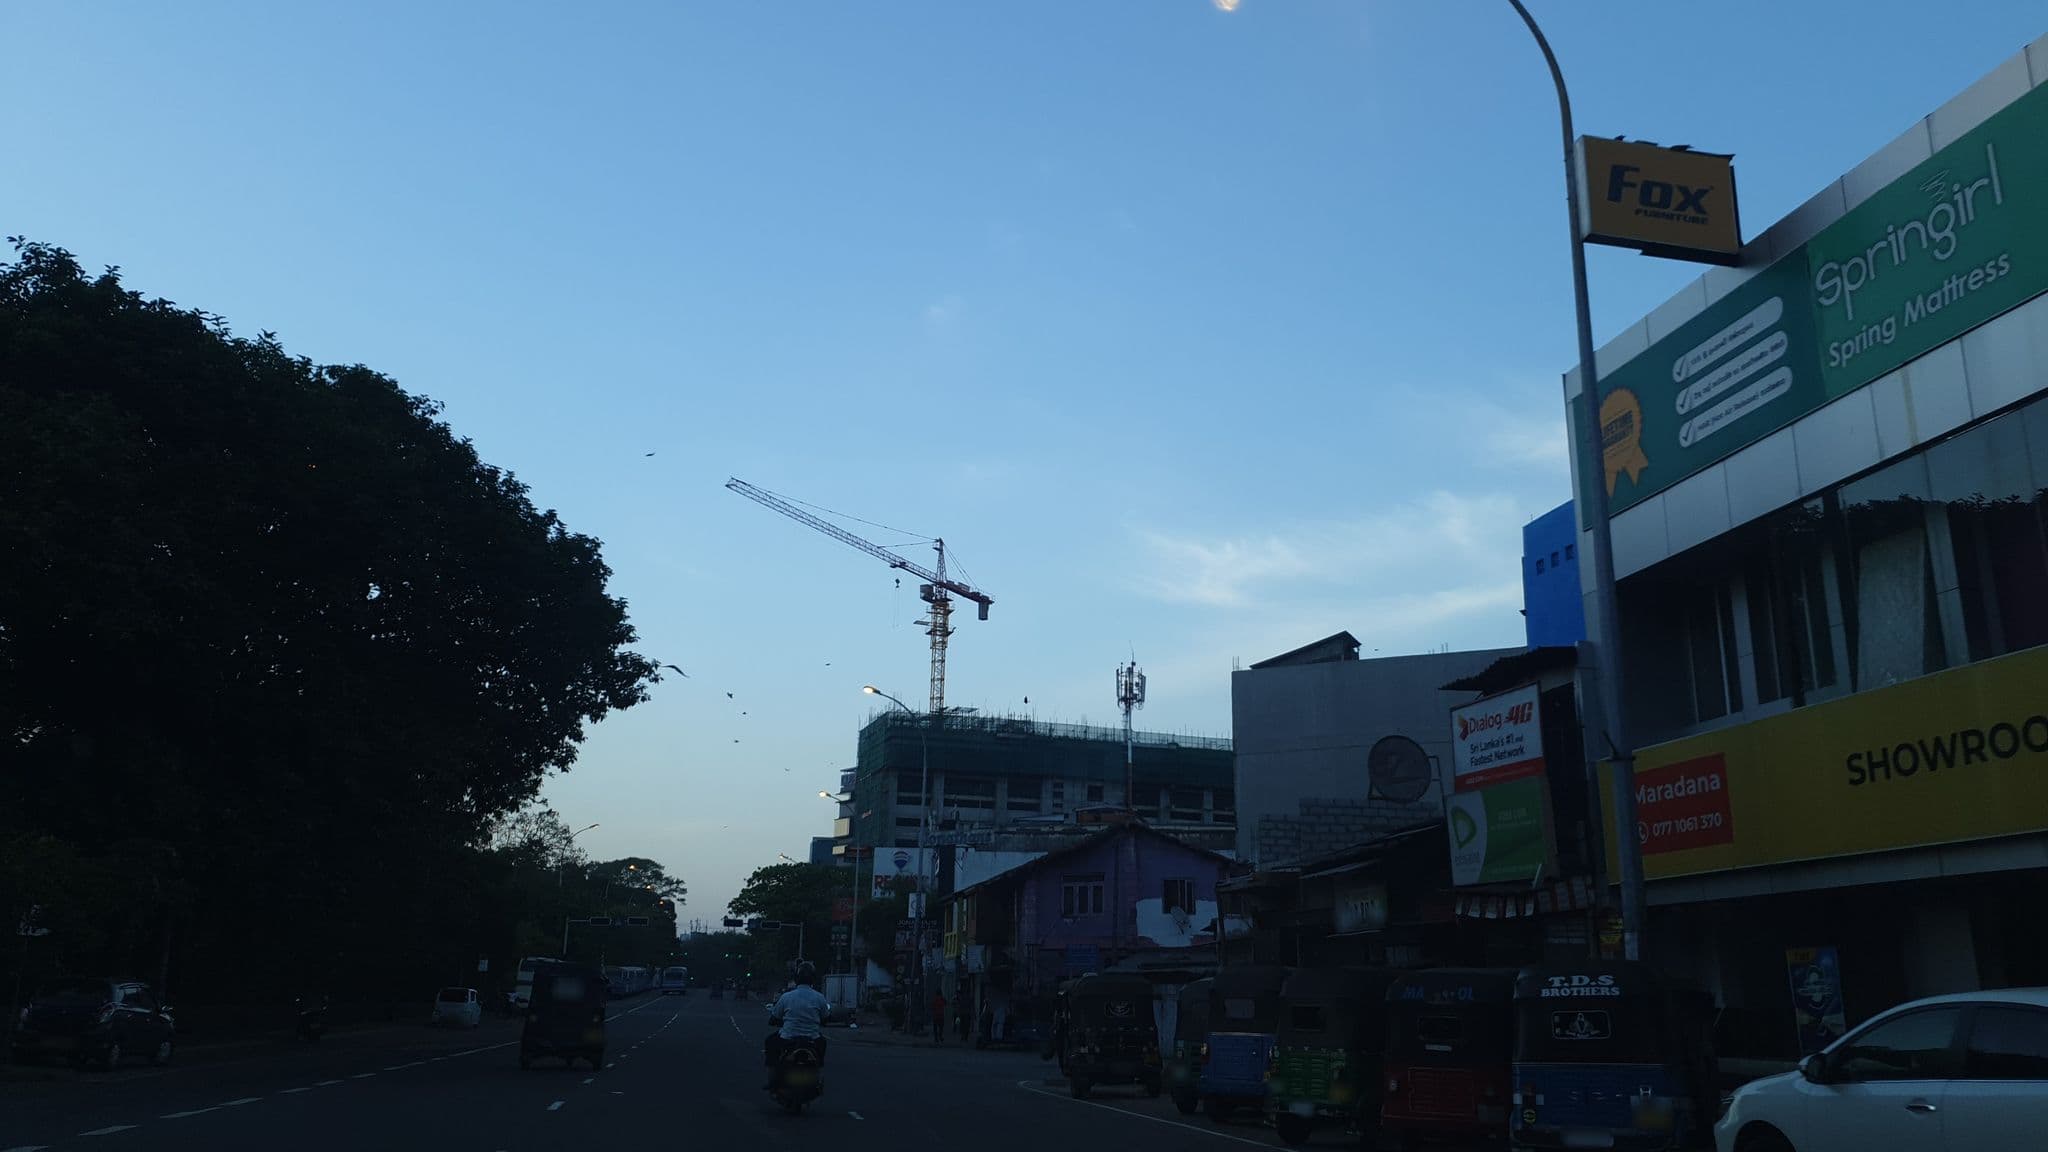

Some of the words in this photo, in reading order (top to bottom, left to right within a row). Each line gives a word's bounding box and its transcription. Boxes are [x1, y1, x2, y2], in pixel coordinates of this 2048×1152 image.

[1635, 208, 1709, 225] FURNITURE
[1815, 143, 2002, 321] Springirl
[1828, 316, 1896, 368] Spring
[1904, 253, 2010, 327] Mattress
[1469, 712, 1502, 733] Dialog
[1470, 743, 1479, 754] Sri
[1480, 736, 1504, 751] Lanka's
[1470, 753, 1493, 767] Fastest
[1494, 745, 1525, 761] Network
[1634, 773, 1721, 804] Maradana
[1652, 820, 1672, 837] 077
[1700, 812, 1722, 830] 370
[1548, 974, 1615, 988] T.D.S
[1540, 986, 1620, 998] BROTHERS
